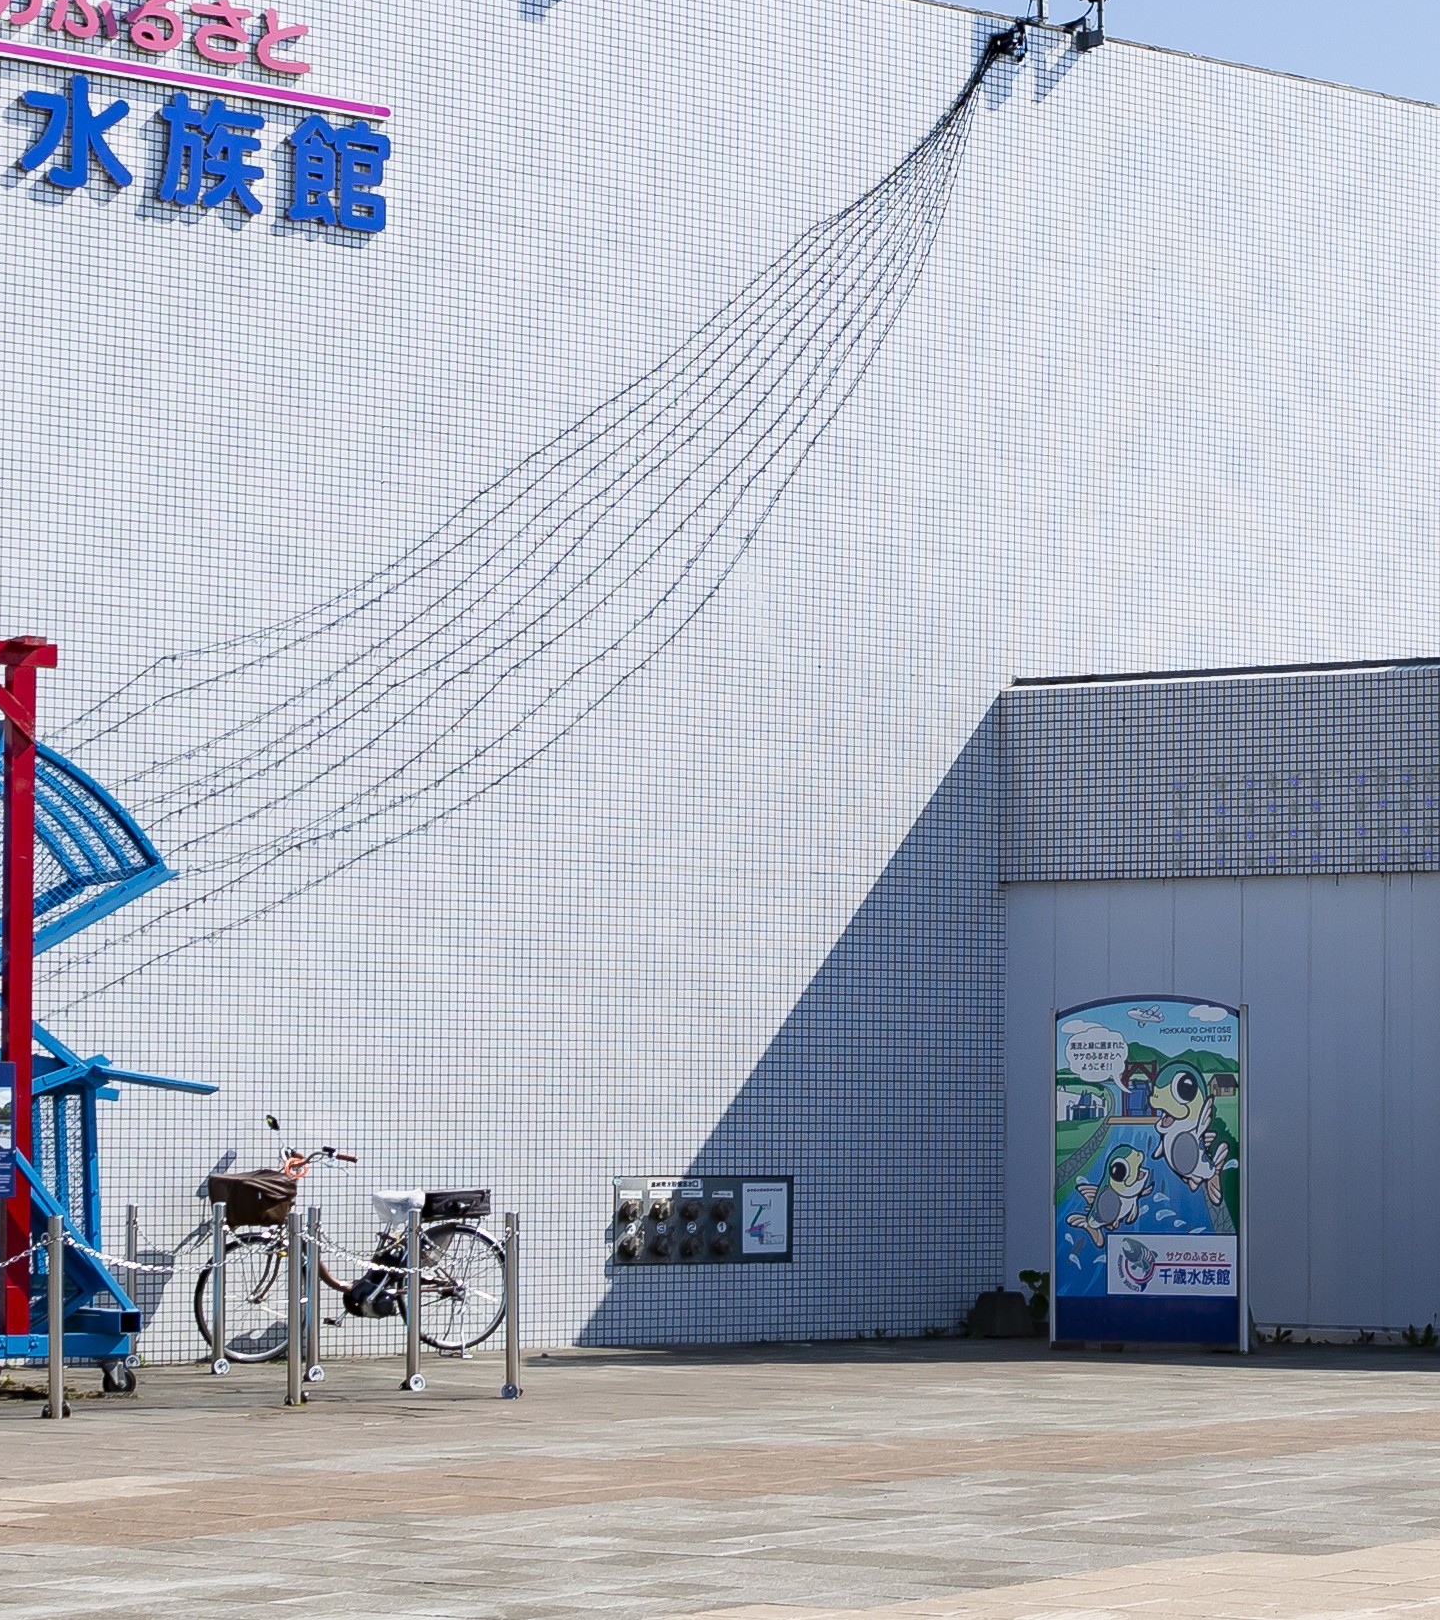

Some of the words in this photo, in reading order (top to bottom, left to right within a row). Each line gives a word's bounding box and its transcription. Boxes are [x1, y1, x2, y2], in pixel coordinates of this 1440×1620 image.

[1159, 1026, 1198, 1035] HOKKAIDO
[1199, 1025, 1232, 1034] CHITOSE
[1190, 1035, 1216, 1043] ROUTE
[1073, 1052, 1122, 1061] サケのふるさとへ
[1165, 1251, 1226, 1262] サケのふるさと
[1158, 1267, 1231, 1286] 千歳水族館
